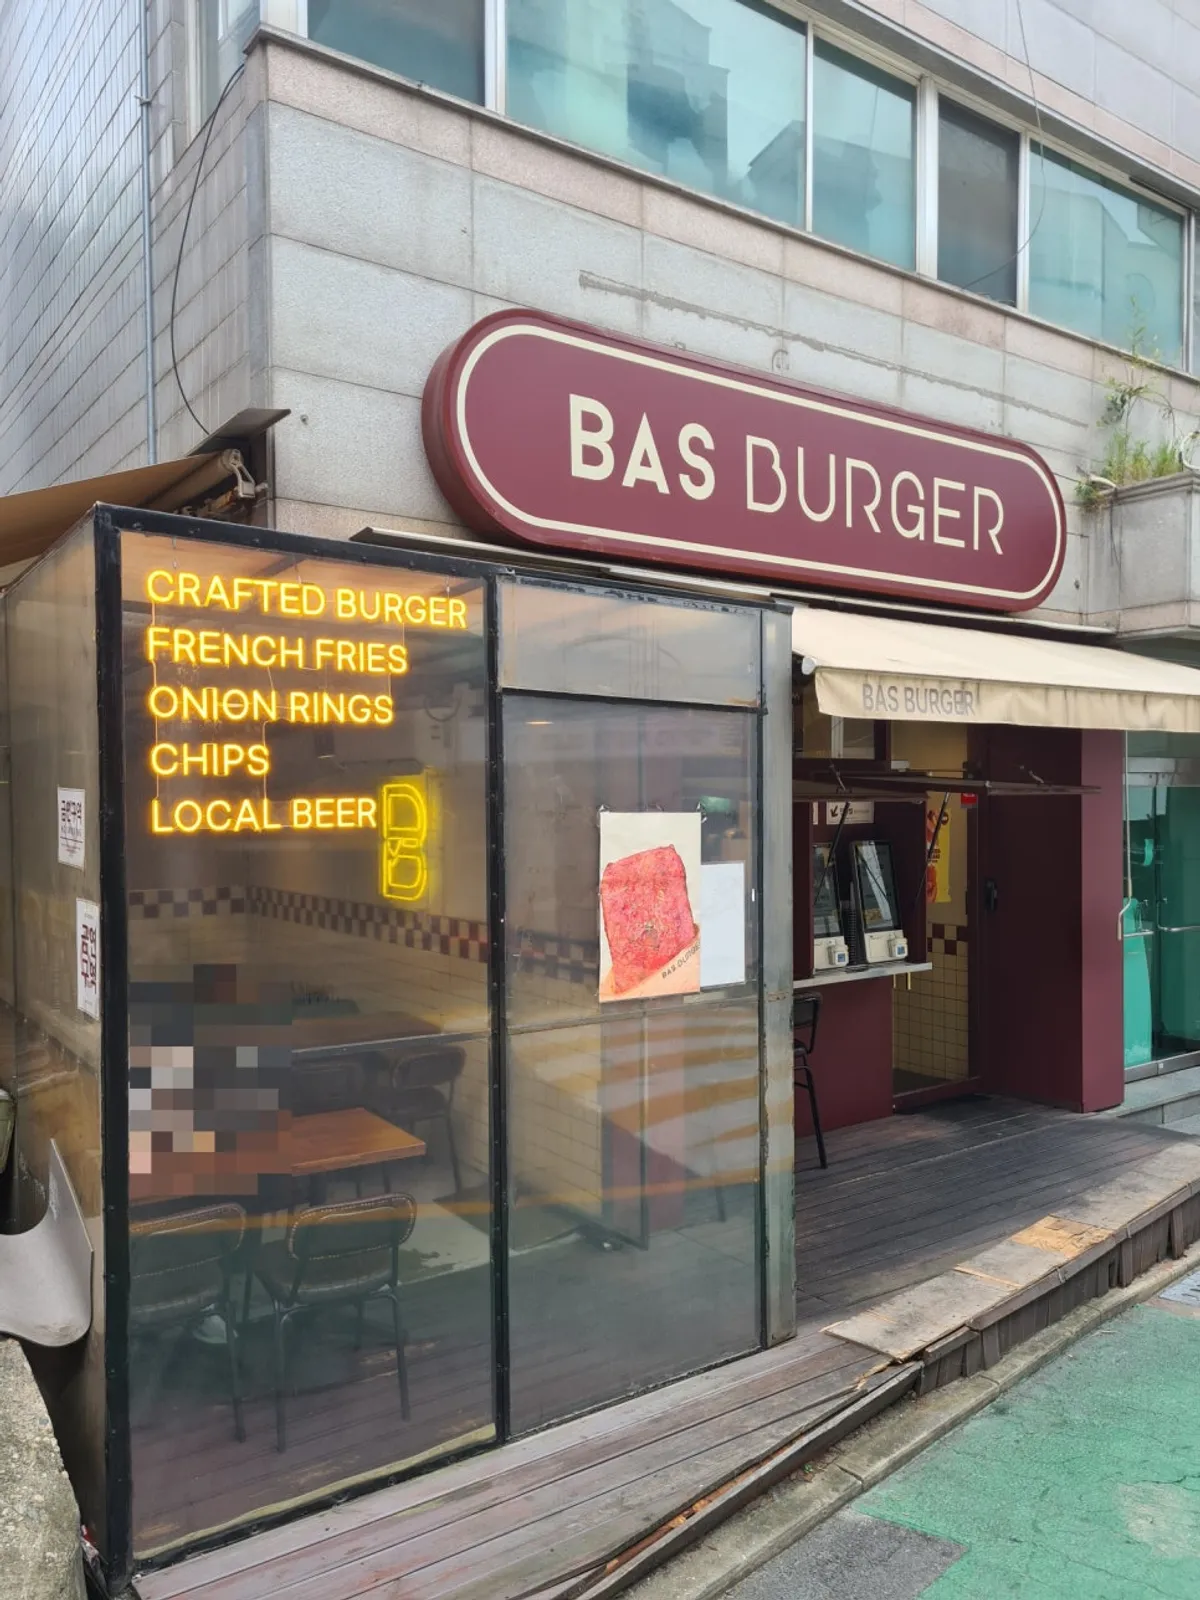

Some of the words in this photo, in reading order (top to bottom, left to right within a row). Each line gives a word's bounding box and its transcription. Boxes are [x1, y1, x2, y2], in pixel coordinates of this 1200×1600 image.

[569, 393, 716, 500] BAS
[746, 434, 1005, 555] BURGER
[146, 569, 326, 616] CRAFTED
[336, 587, 468, 629] BURGER
[147, 626, 305, 669] FRENCH
[316, 639, 409, 674] FRIES
[149, 686, 277, 722] ONION
[290, 691, 394, 725] RINGS
[862, 683, 899, 713] BAS
[904, 686, 976, 717] BURGER
[151, 743, 270, 776] CHIPS
[152, 798, 282, 834] LOCAL
[292, 797, 378, 829] BEER
